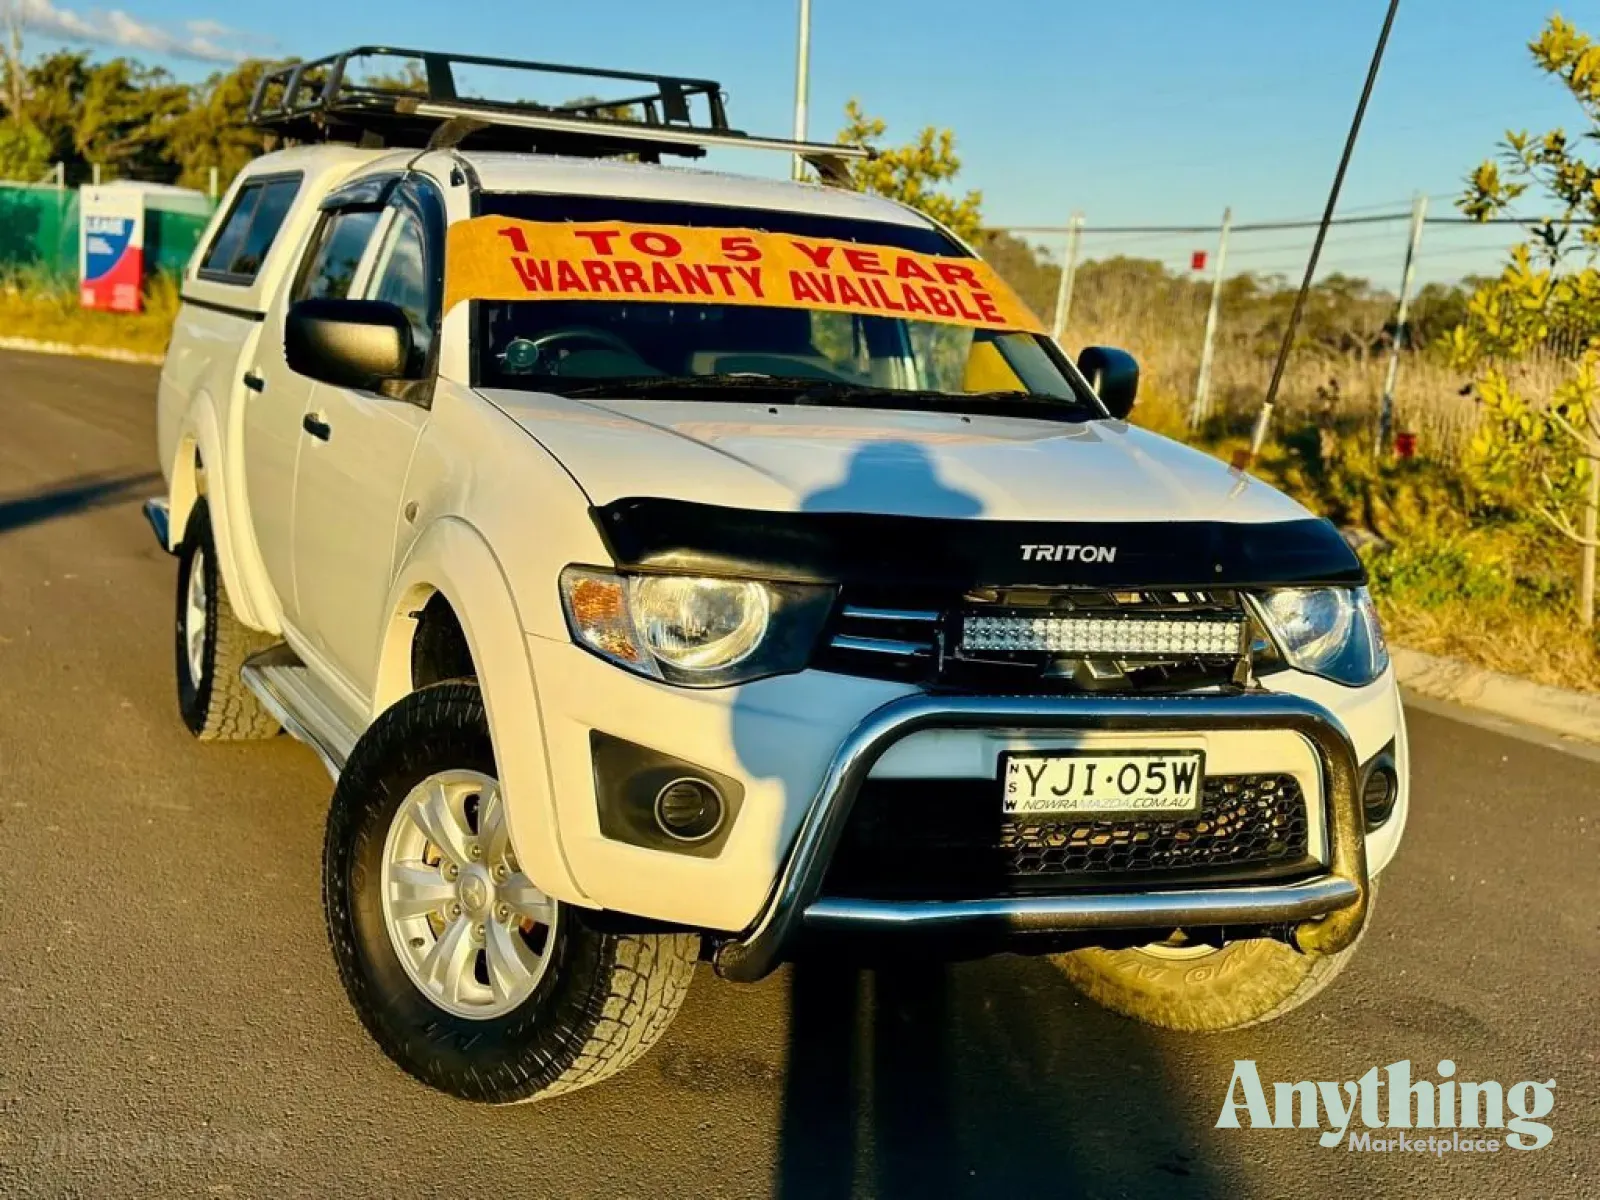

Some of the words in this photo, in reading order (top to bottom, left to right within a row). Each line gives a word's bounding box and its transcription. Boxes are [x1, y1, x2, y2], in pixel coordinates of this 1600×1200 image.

[498, 226, 529, 253] 1
[574, 229, 682, 259] TO
[721, 237, 763, 262] 5
[789, 241, 984, 289] YEAR
[511, 257, 765, 298] WARRANTY
[789, 270, 1006, 324] AVAILABLE
[1020, 544, 1117, 563] TRITON
